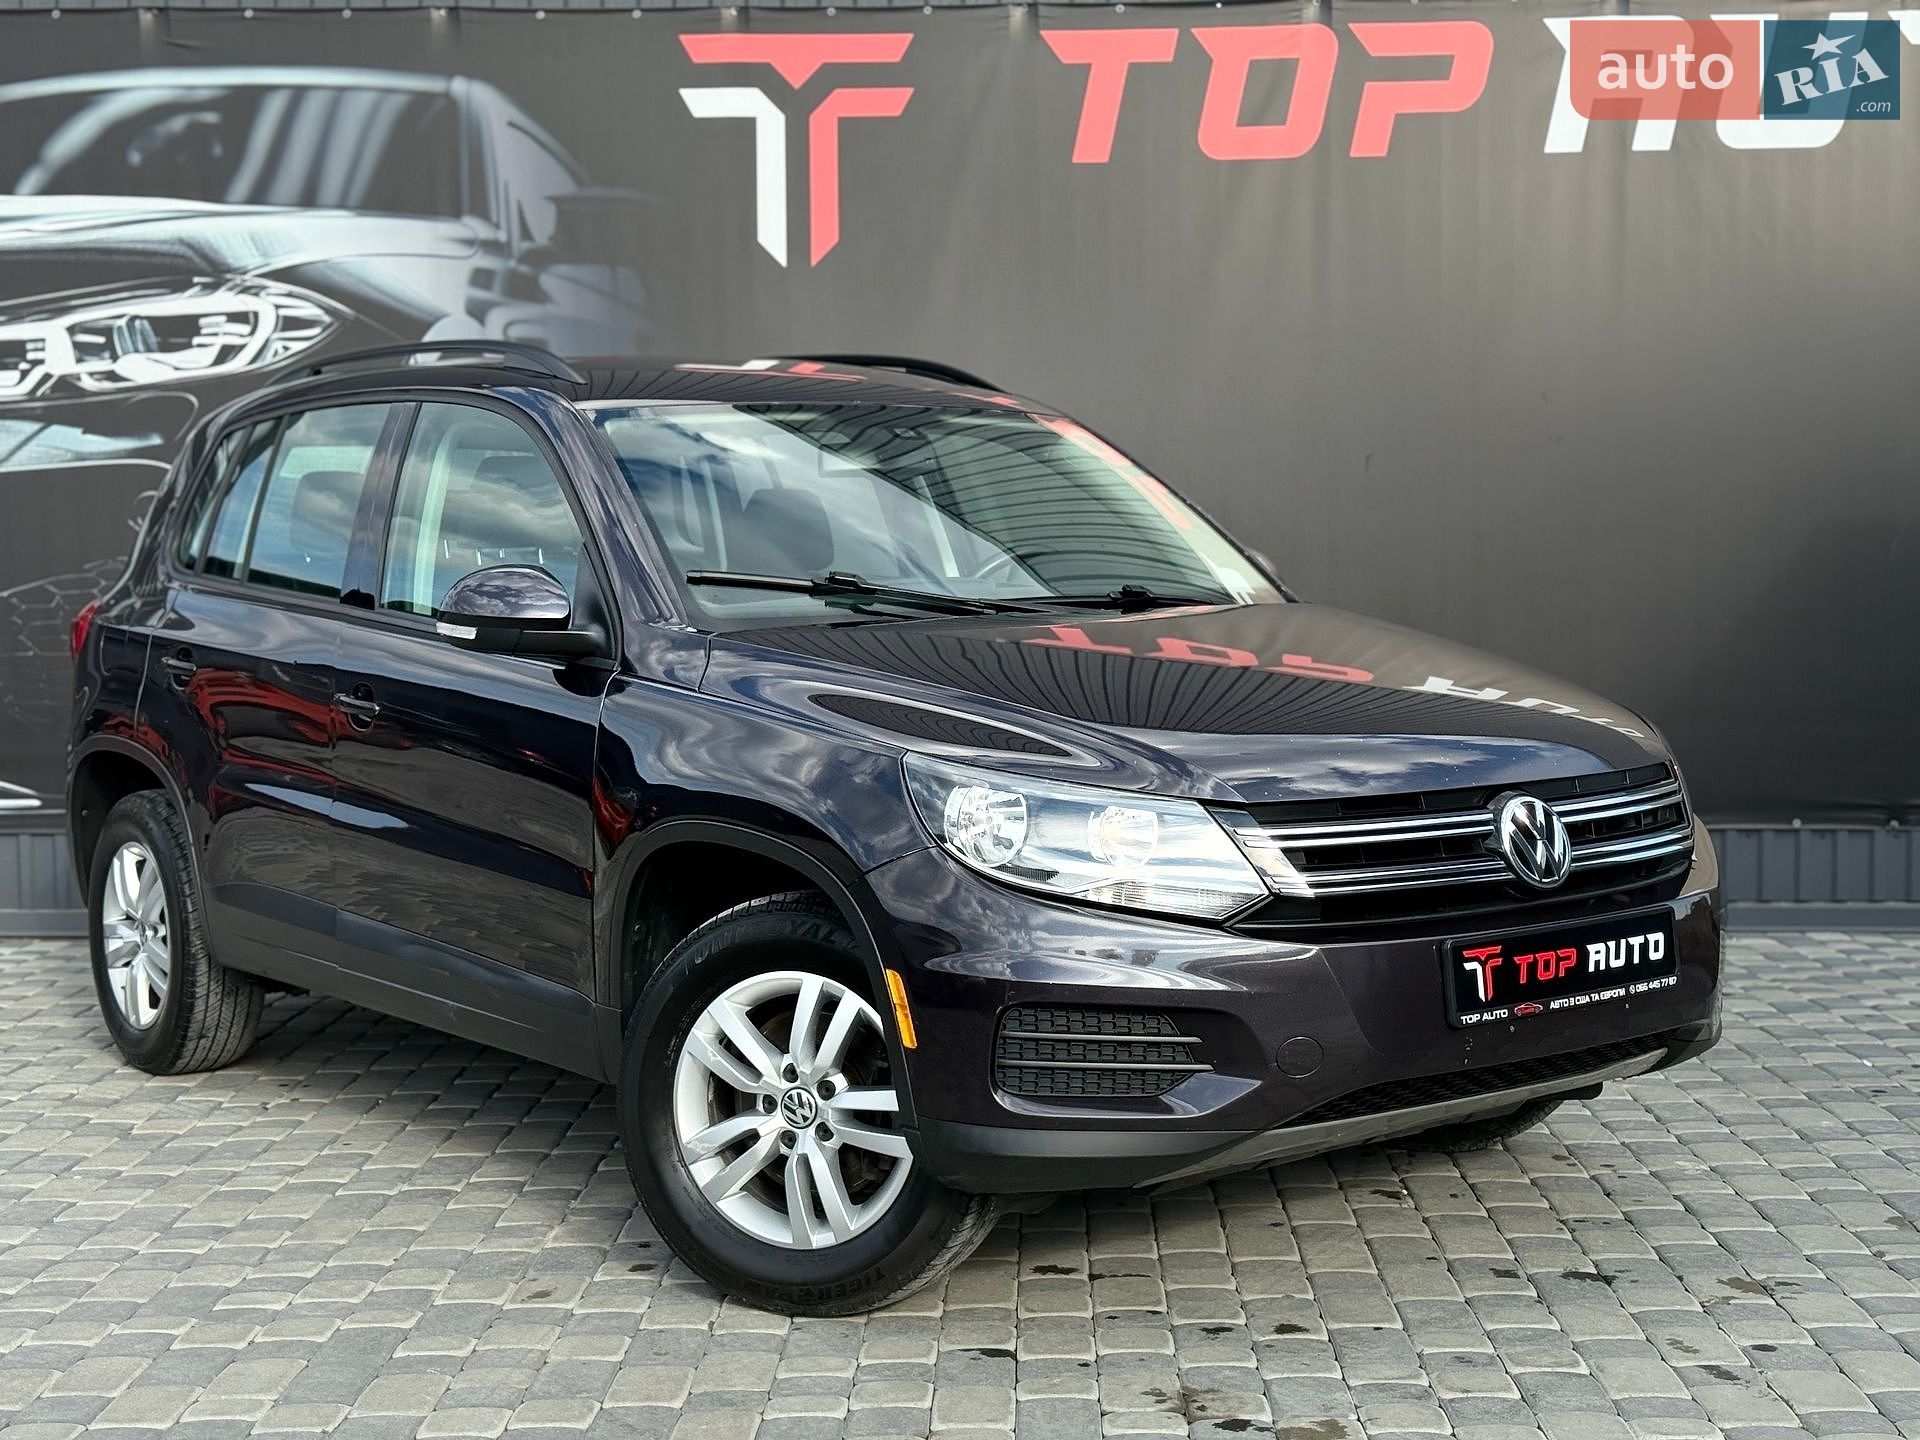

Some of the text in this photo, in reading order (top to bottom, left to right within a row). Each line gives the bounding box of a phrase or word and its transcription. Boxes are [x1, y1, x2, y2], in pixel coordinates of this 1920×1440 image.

[1039, 10, 1920, 164] TOP AU
[1513, 931, 1665, 984] TOP AUTO
[1660, 978, 1669, 987] 77
[1460, 1009, 1509, 1025] TOP AUTO
